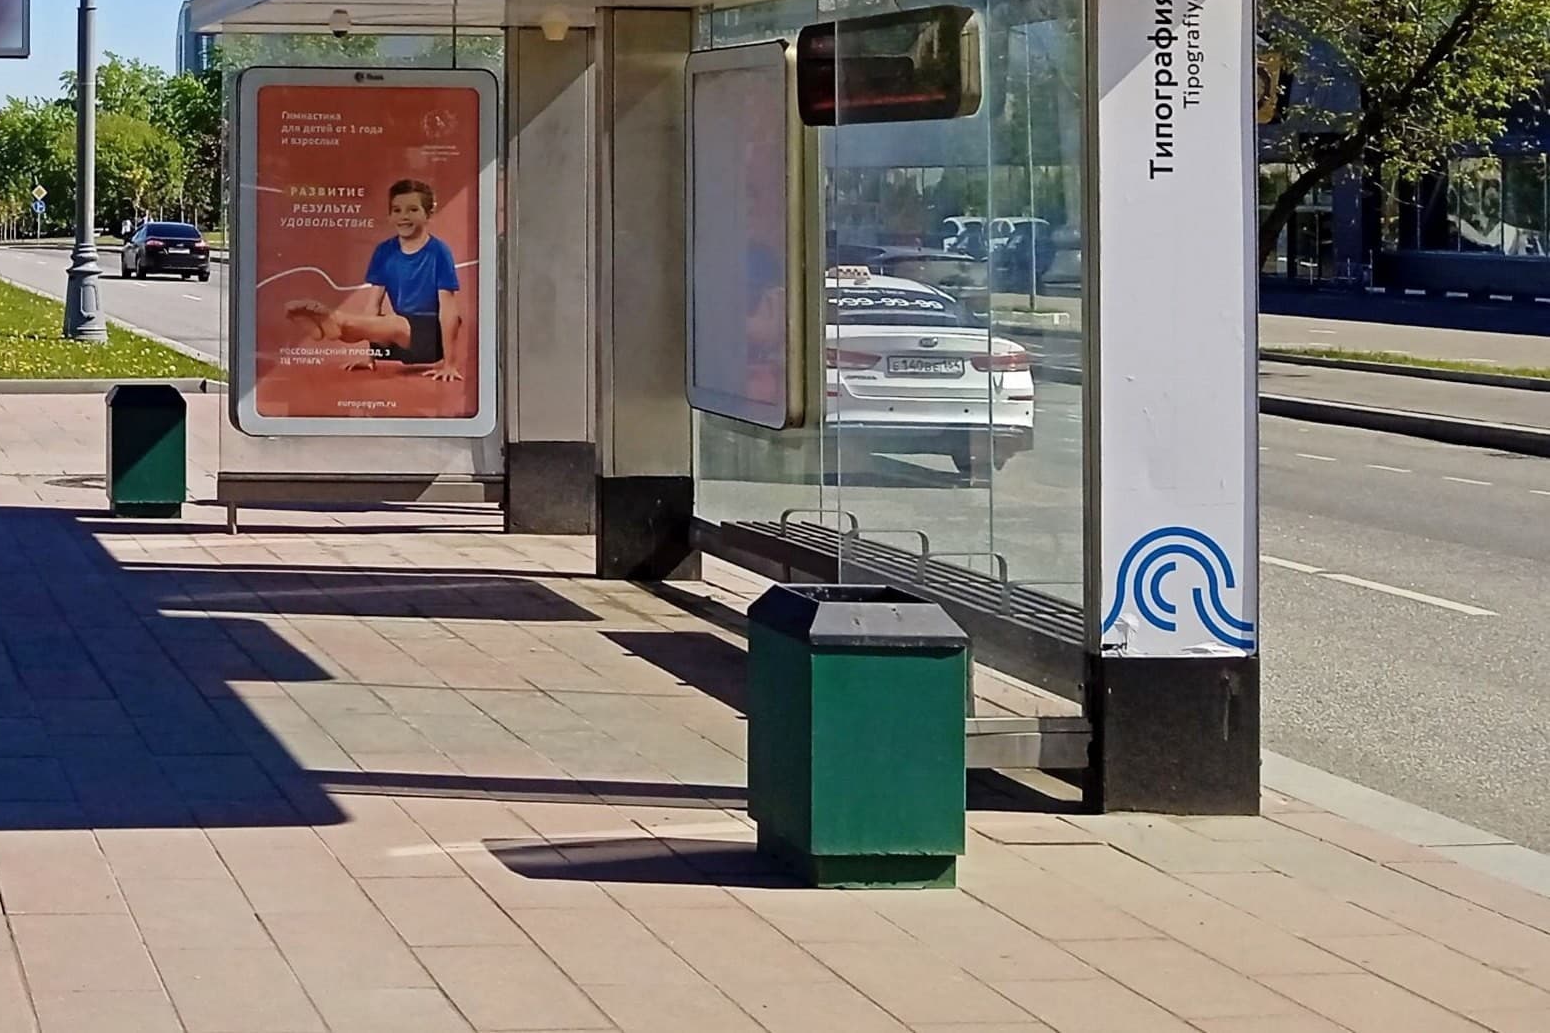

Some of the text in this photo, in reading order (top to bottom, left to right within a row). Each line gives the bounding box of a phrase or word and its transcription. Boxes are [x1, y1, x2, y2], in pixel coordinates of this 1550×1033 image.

[281, 125, 300, 134] для
[302, 123, 333, 135] детей
[335, 125, 347, 134] от
[358, 126, 384, 136] года
[290, 187, 365, 197] РАЗВИТИЕ
[293, 204, 362, 213] РЕЗУЛЬТАТ
[280, 217, 375, 228] УДОВОЛЬСТВИЕ
